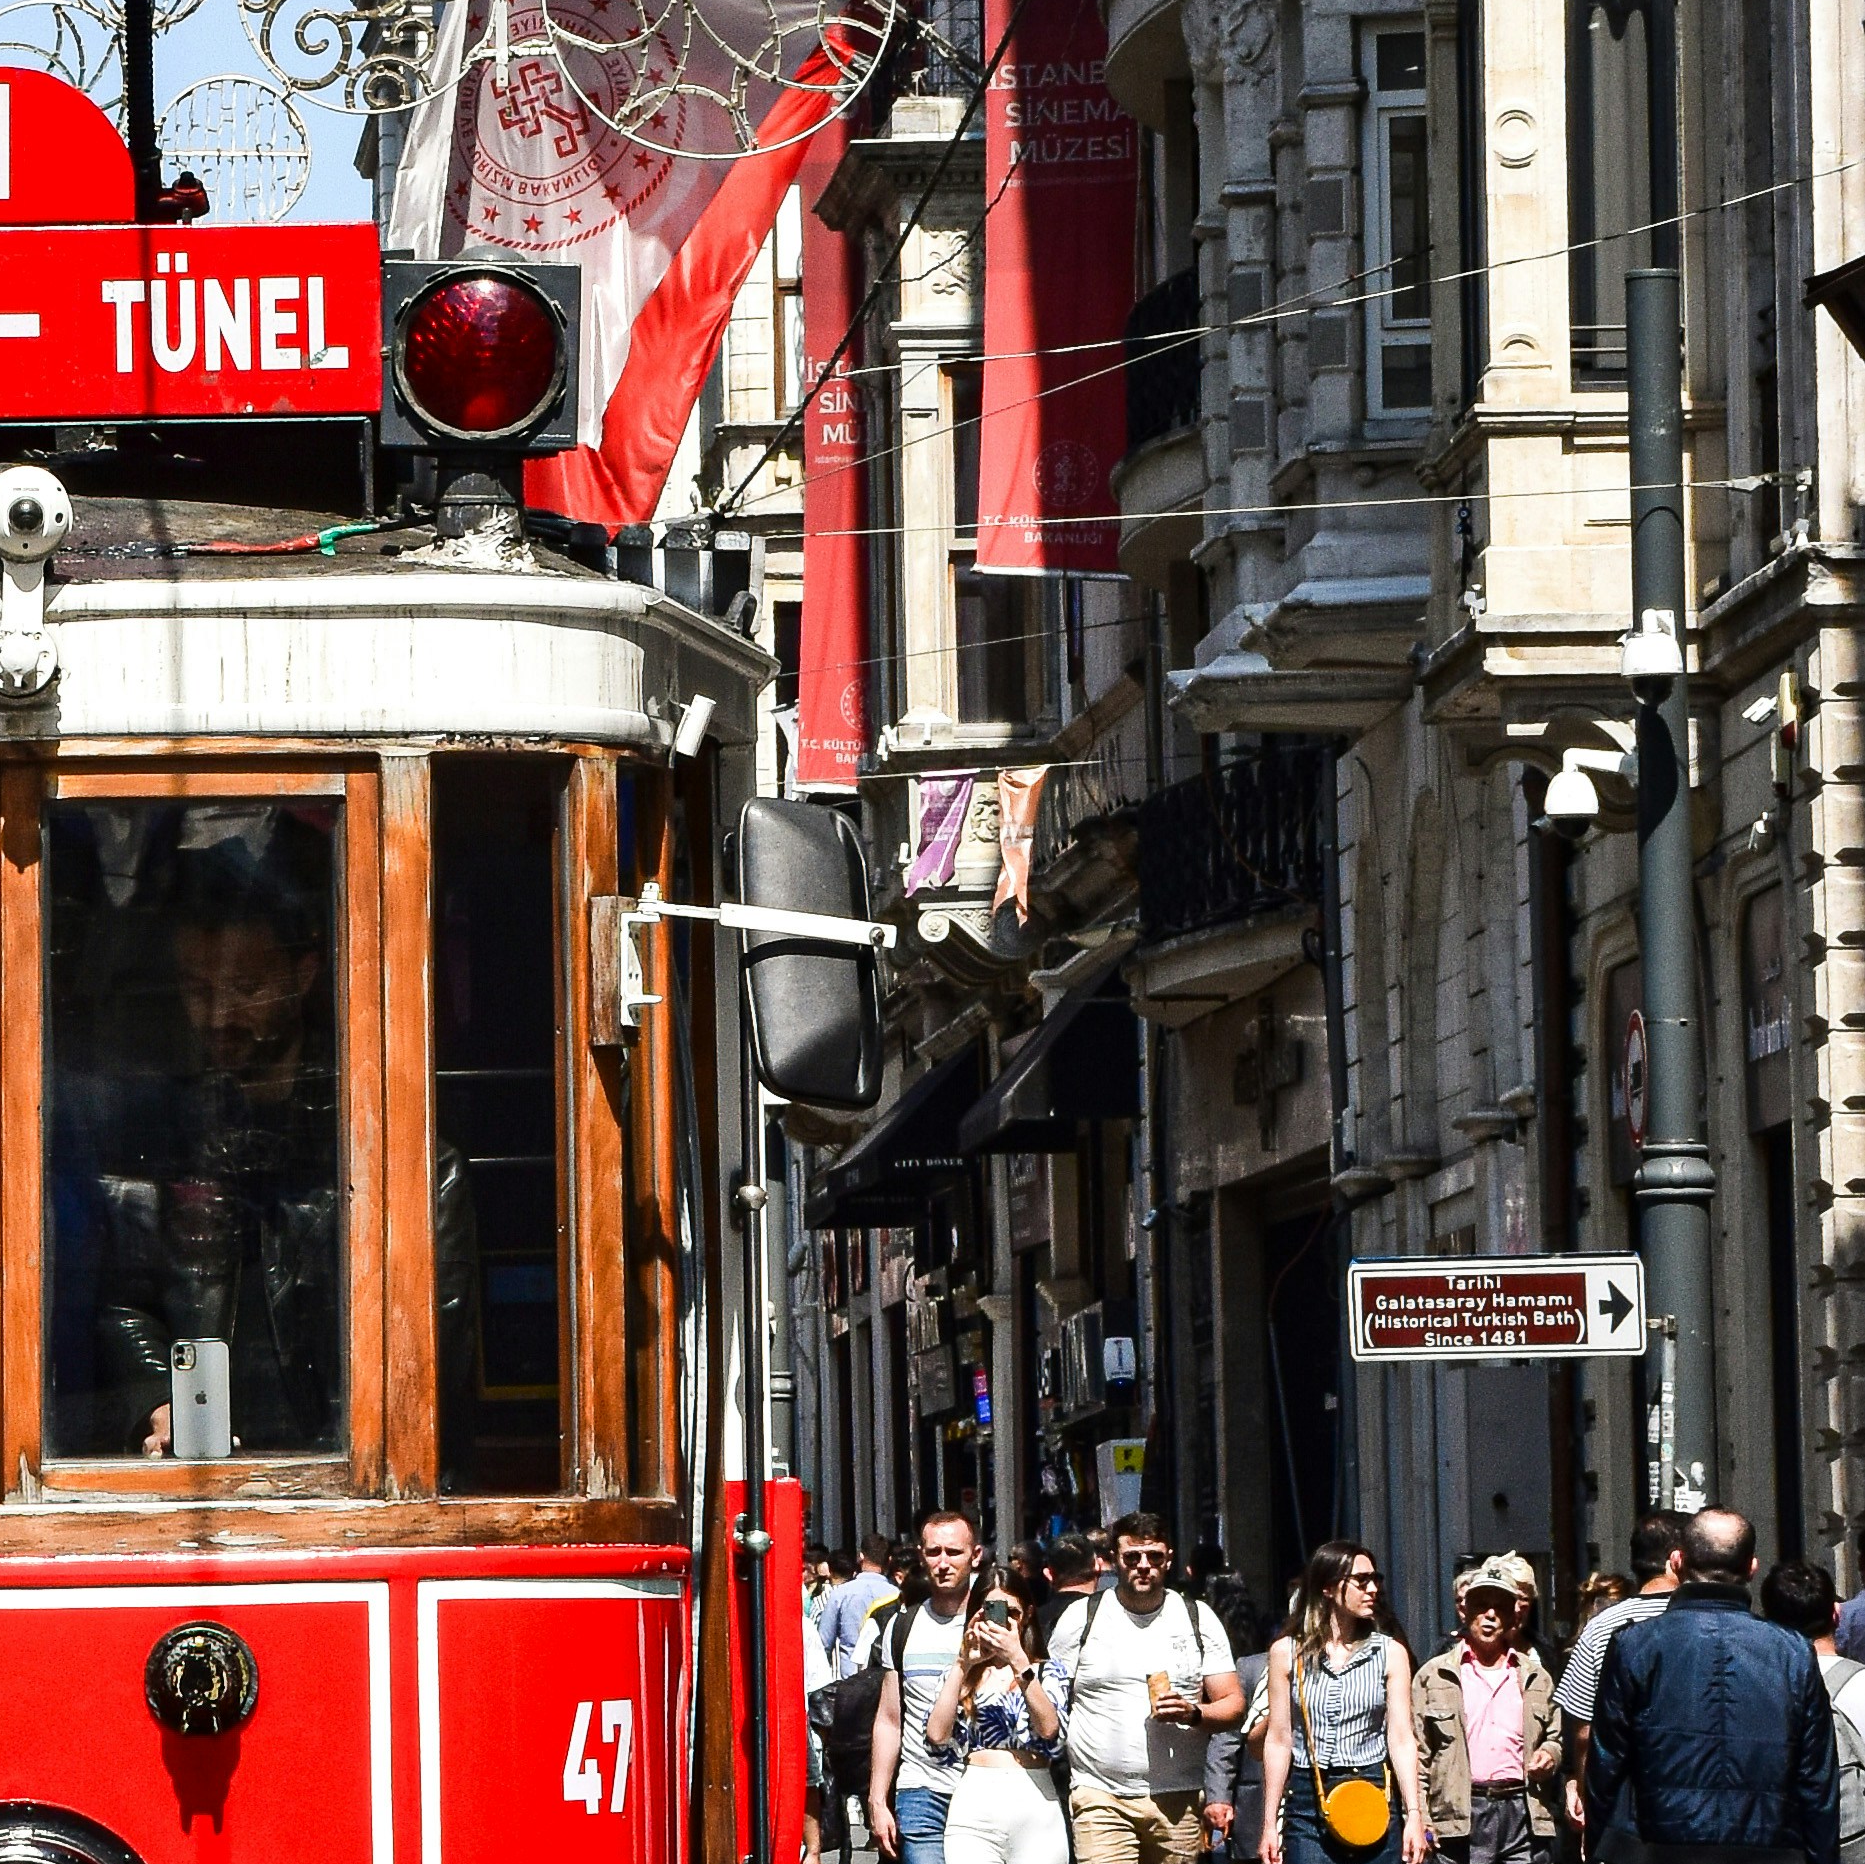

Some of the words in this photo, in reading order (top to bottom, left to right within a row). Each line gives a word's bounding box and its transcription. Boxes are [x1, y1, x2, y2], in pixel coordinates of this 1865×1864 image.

[1008, 128, 1131, 165] MÜZESİ
[100, 251, 349, 372] TÜNEL
[1445, 1275, 1501, 1290] Tarihi
[1375, 1294, 1486, 1311] Galatasaray
[1461, 1311, 1528, 1327] Turkish
[1424, 1331, 1474, 1347] Since
[1480, 1330, 1526, 1345] 1481
[561, 1698, 633, 1815] 47
